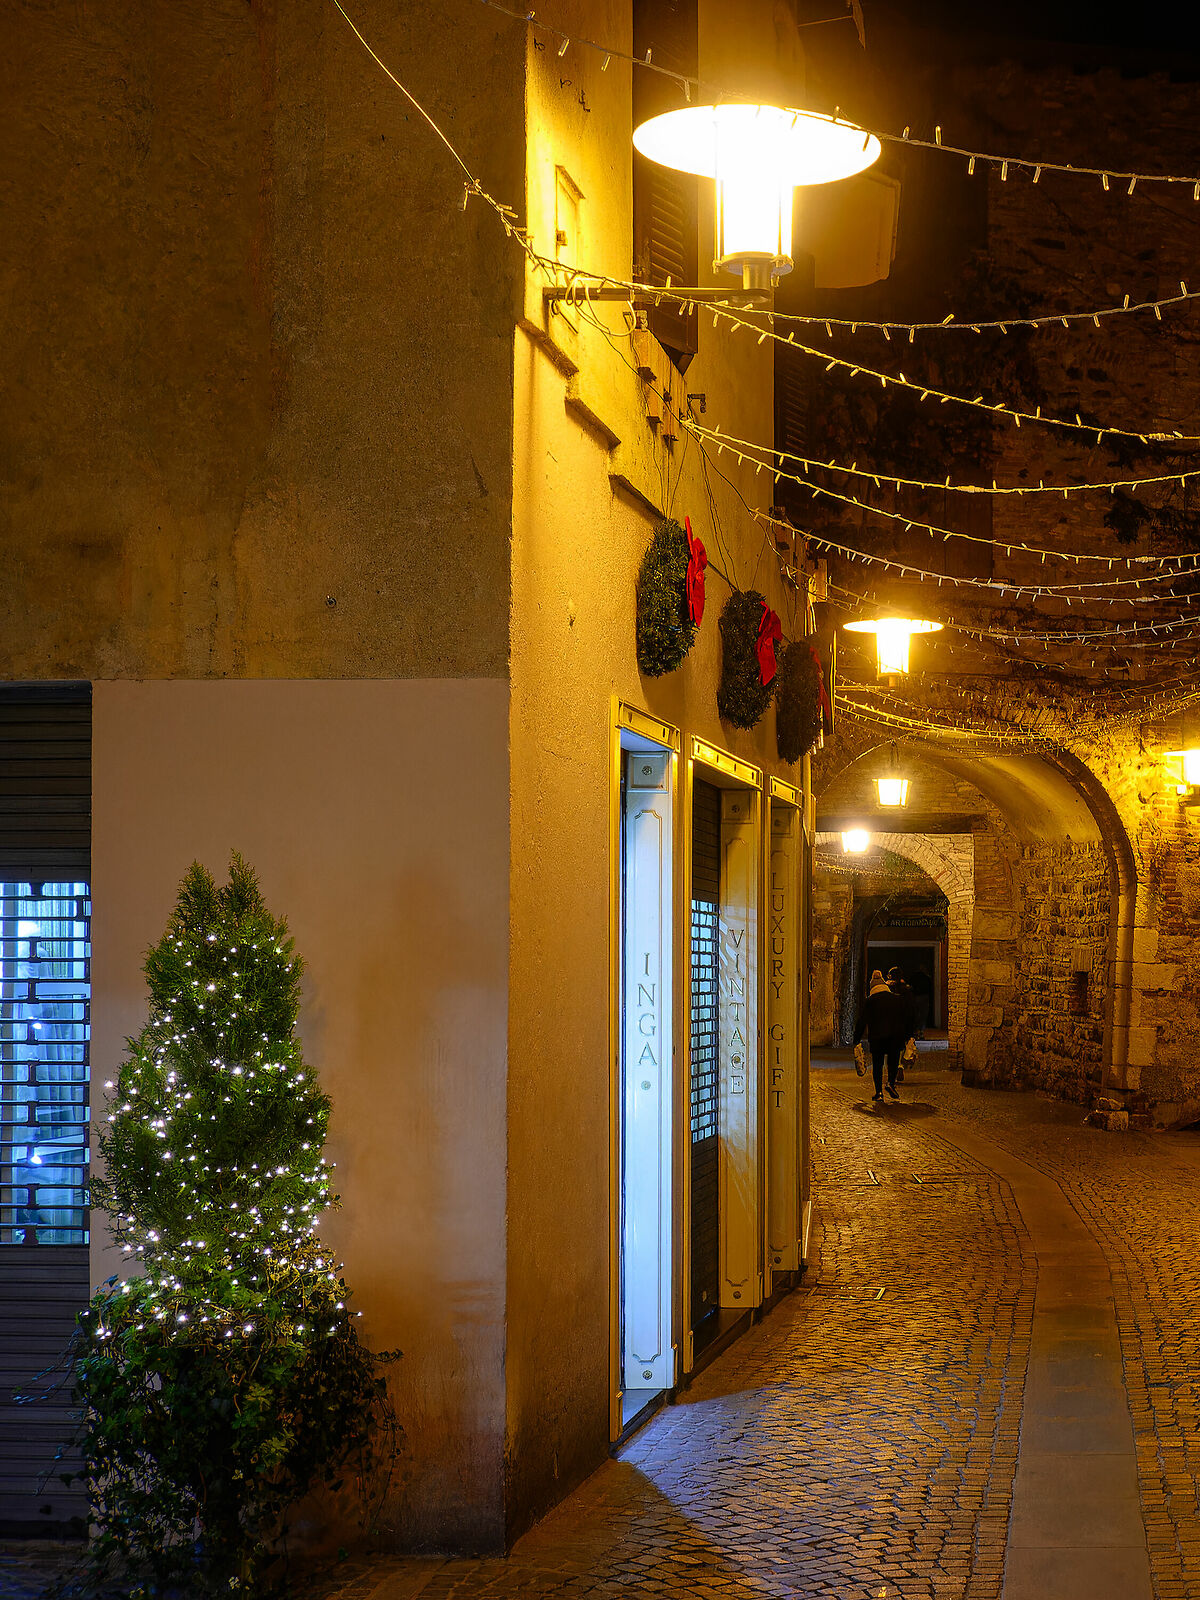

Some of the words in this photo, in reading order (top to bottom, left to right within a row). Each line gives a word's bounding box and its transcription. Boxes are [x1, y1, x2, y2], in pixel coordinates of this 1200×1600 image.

[771, 871, 785, 1000] LUXURY
[636, 952, 658, 1066] INGA
[728, 929, 745, 1095] VINTAGE
[770, 1023, 785, 1108] GIFT
